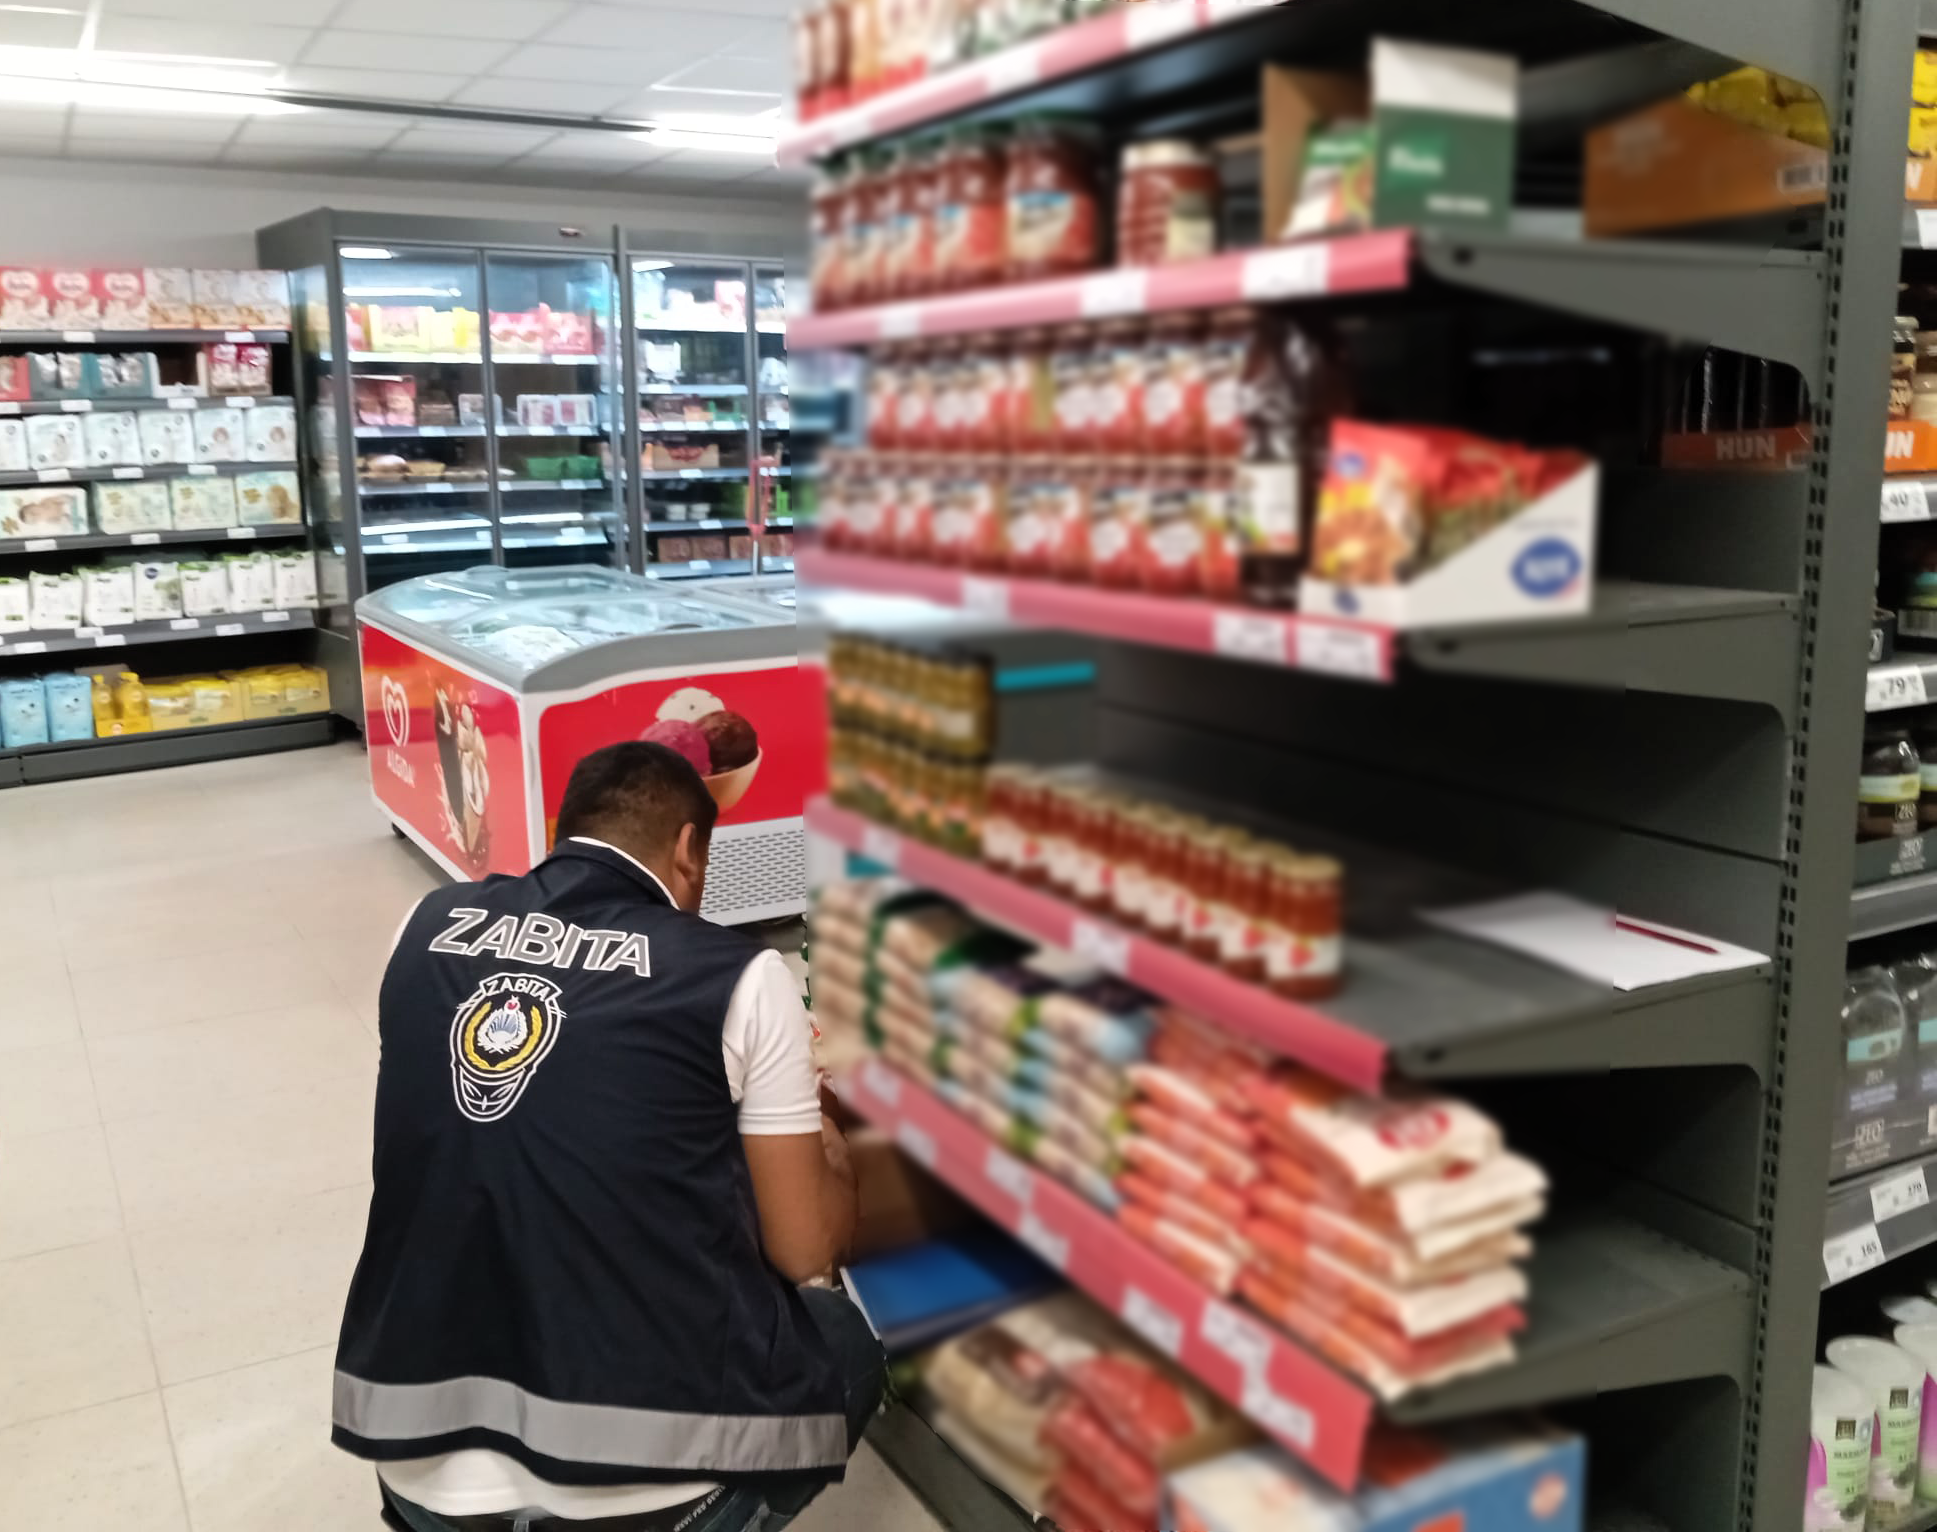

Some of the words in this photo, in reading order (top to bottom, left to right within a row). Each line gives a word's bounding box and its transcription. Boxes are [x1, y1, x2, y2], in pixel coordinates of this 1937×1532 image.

[1716, 434, 1776, 460] HUN
[428, 907, 651, 977] ZABITA
[486, 976, 552, 1002] ZABITA
